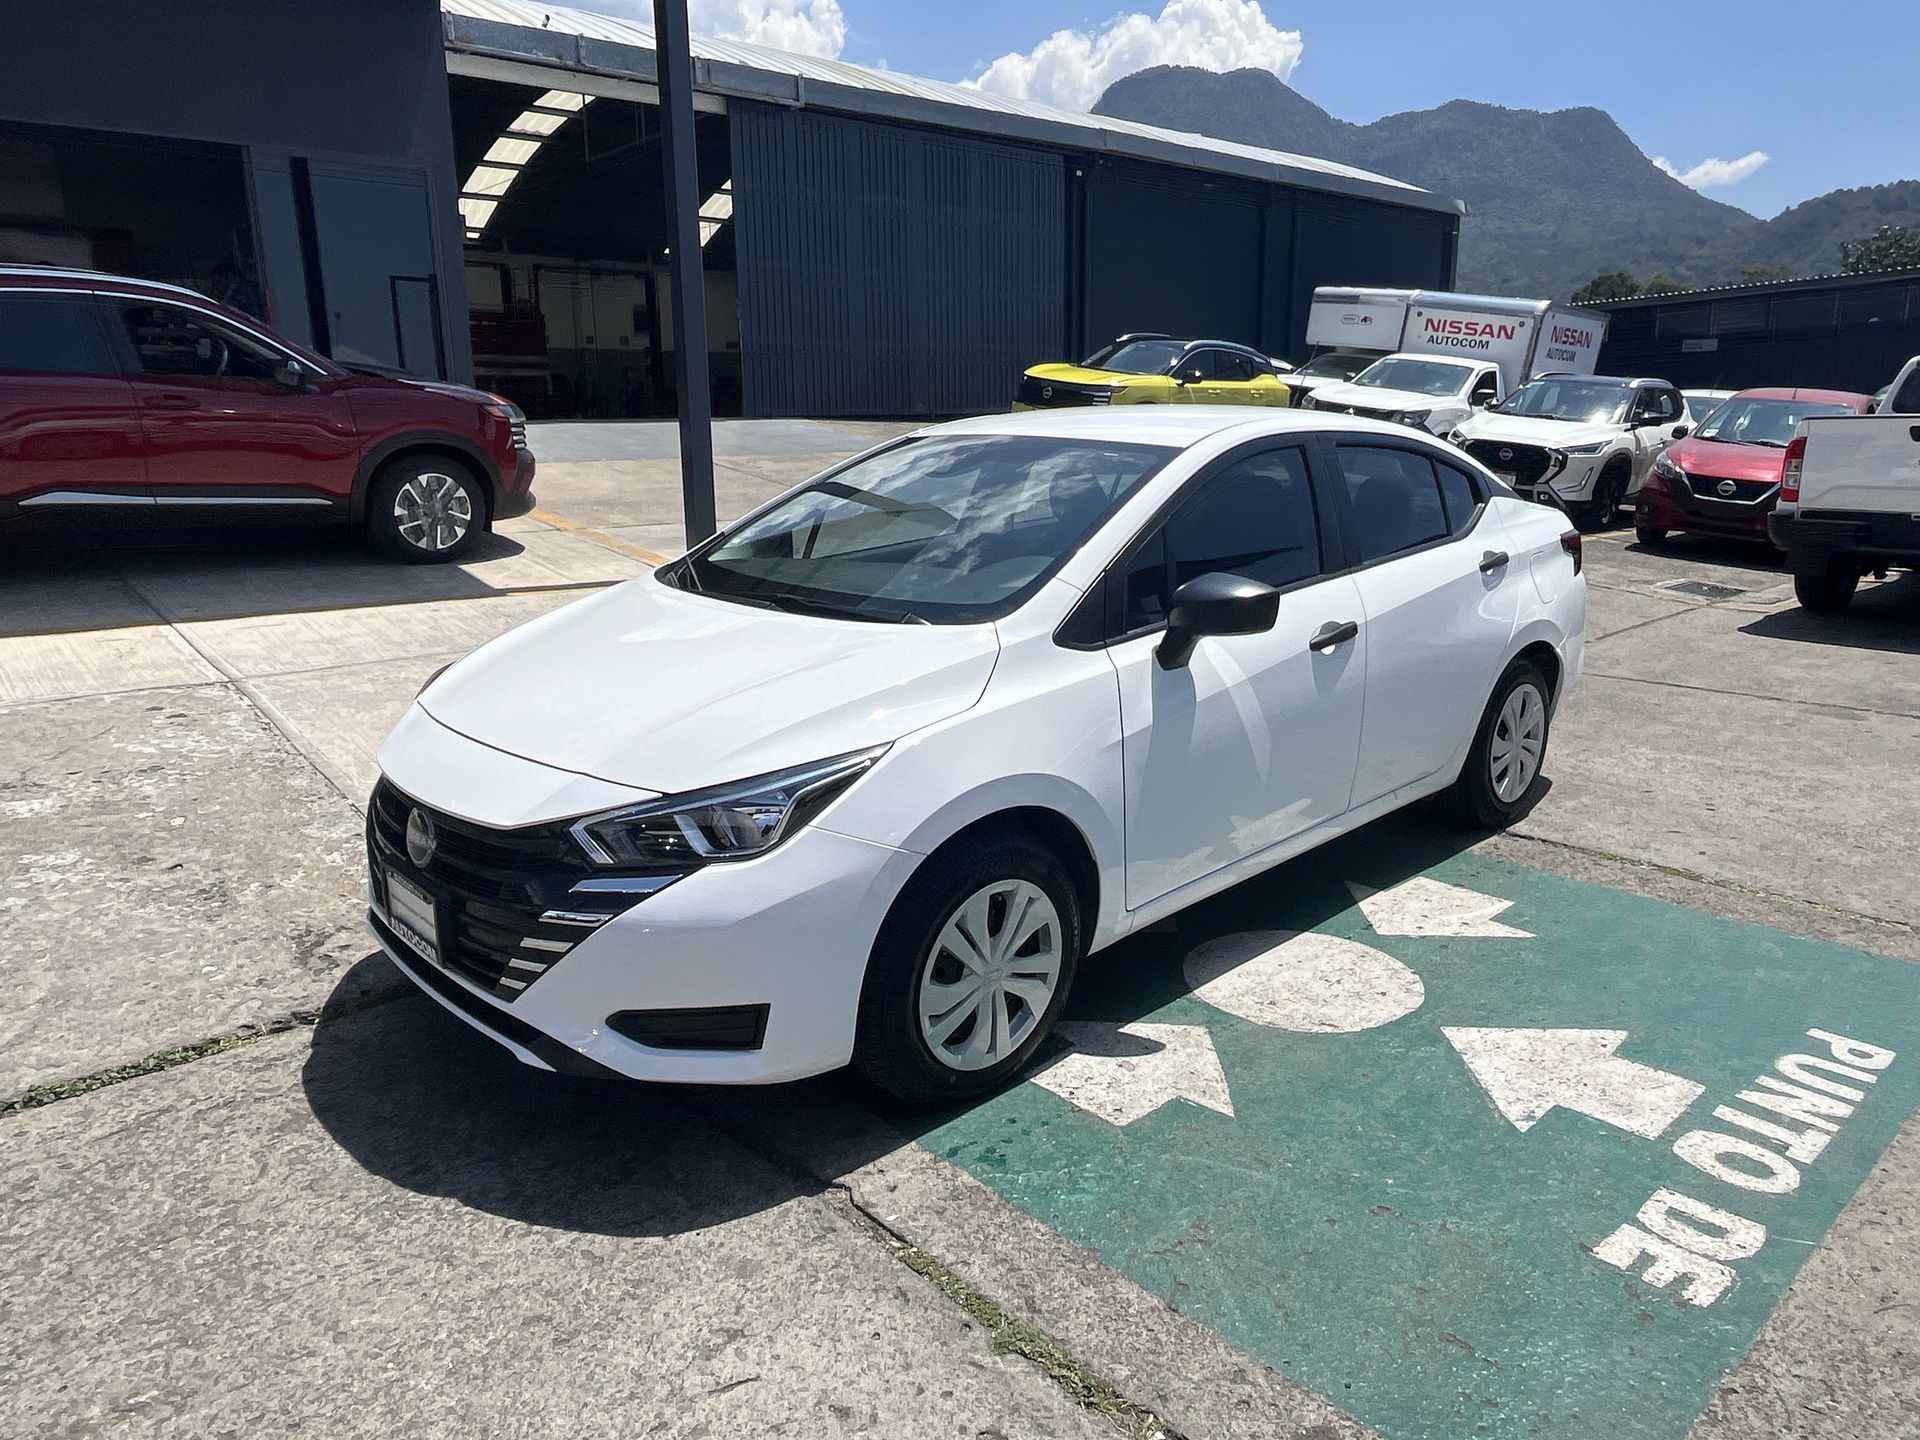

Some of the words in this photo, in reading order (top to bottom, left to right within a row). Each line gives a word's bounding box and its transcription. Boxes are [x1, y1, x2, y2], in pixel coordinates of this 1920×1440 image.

[1424, 317, 1516, 340] NISSAN
[1551, 325, 1593, 349] NISSAN
[1426, 334, 1490, 350] AUTOCOM
[1546, 347, 1577, 363] AUTOCOM
[1672, 1027, 1897, 1195] PUNTO
[1592, 1186, 1767, 1308] DE
